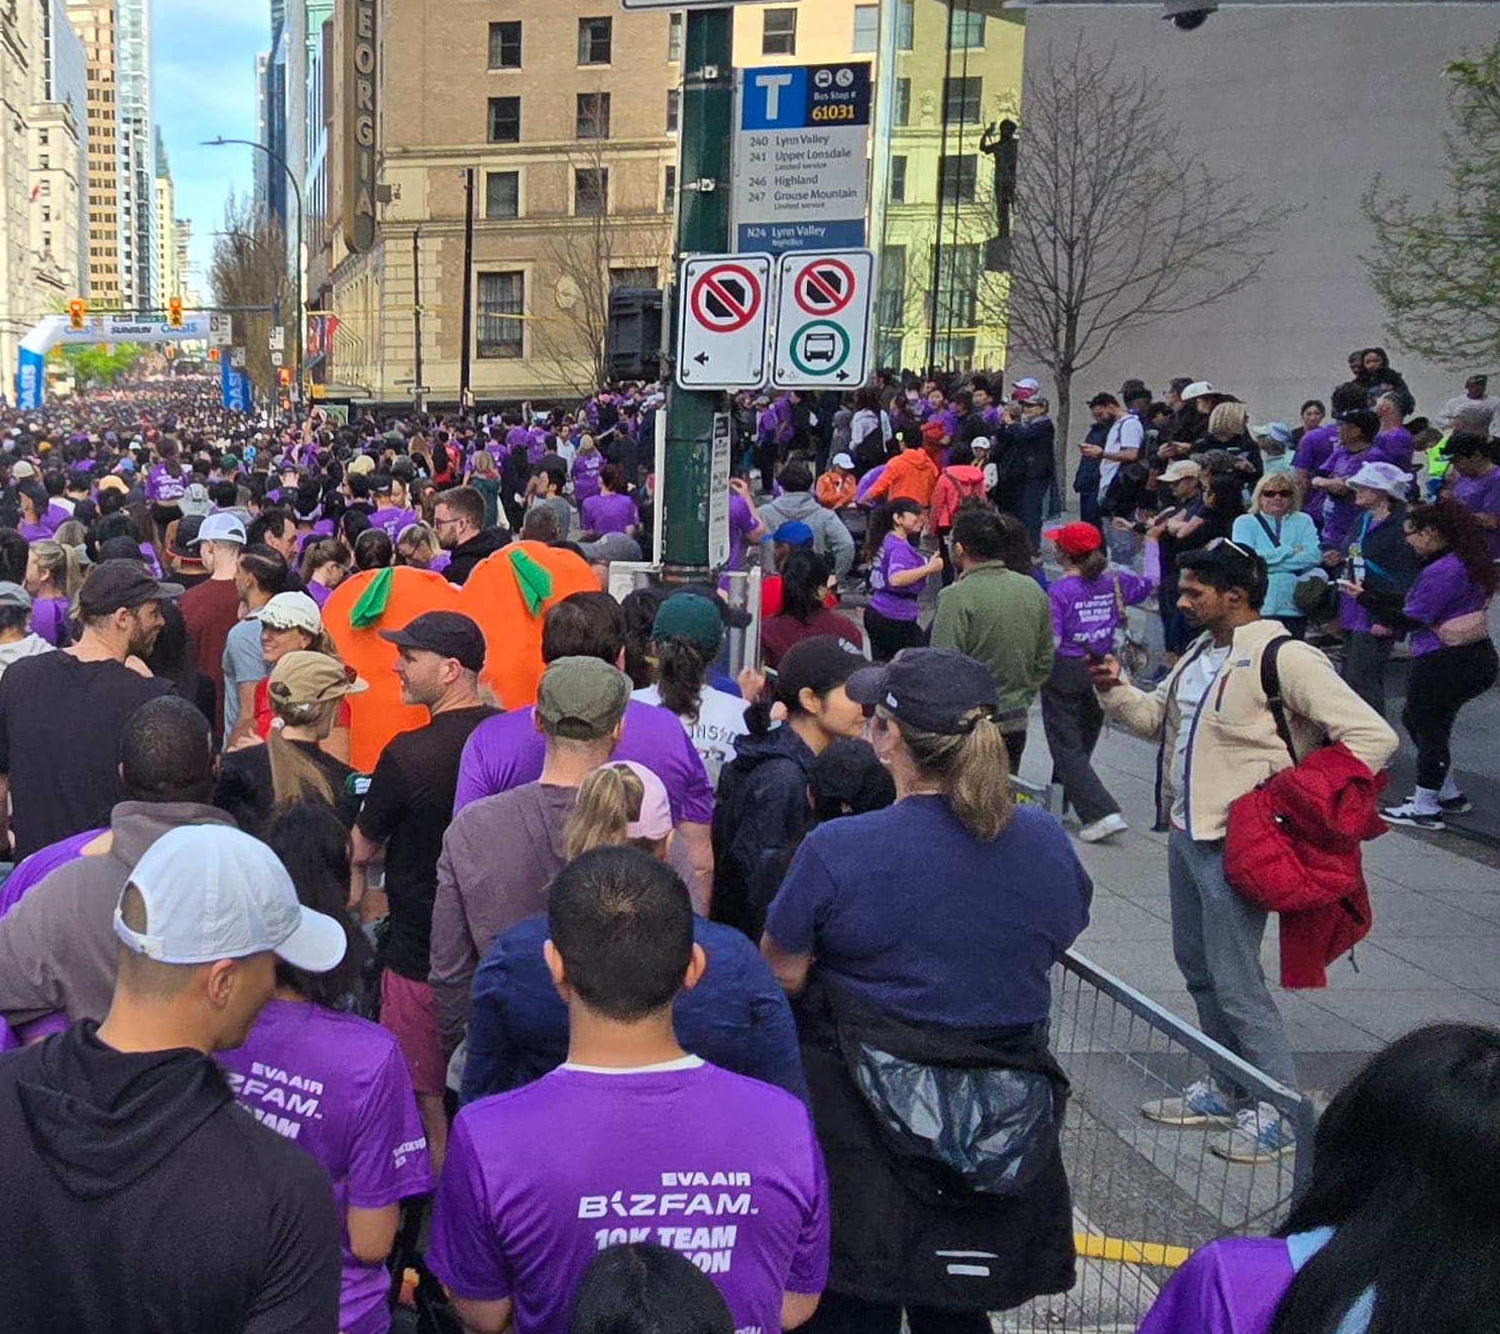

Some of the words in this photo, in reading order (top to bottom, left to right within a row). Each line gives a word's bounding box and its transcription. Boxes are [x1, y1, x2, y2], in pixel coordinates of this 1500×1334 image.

[756, 73, 792, 120] T
[814, 91, 829, 101] Bus
[831, 90, 850, 101] Stop
[812, 104, 854, 121] 61031
[749, 136, 769, 147] 240
[775, 135, 799, 148] Lynn
[800, 134, 829, 146] Valley
[749, 153, 766, 162] 241
[775, 151, 805, 163] Upper
[807, 148, 851, 160] Lonsdale
[748, 177, 767, 187] 246
[775, 174, 818, 188] Highland
[748, 192, 766, 202] 247
[774, 190, 809, 201] Grouse
[811, 187, 857, 199] Mountain
[747, 227, 766, 237] N24
[772, 226, 795, 239] Lynn
[797, 225, 826, 238] Valley
[657, 1225, 737, 1250] TEAM
